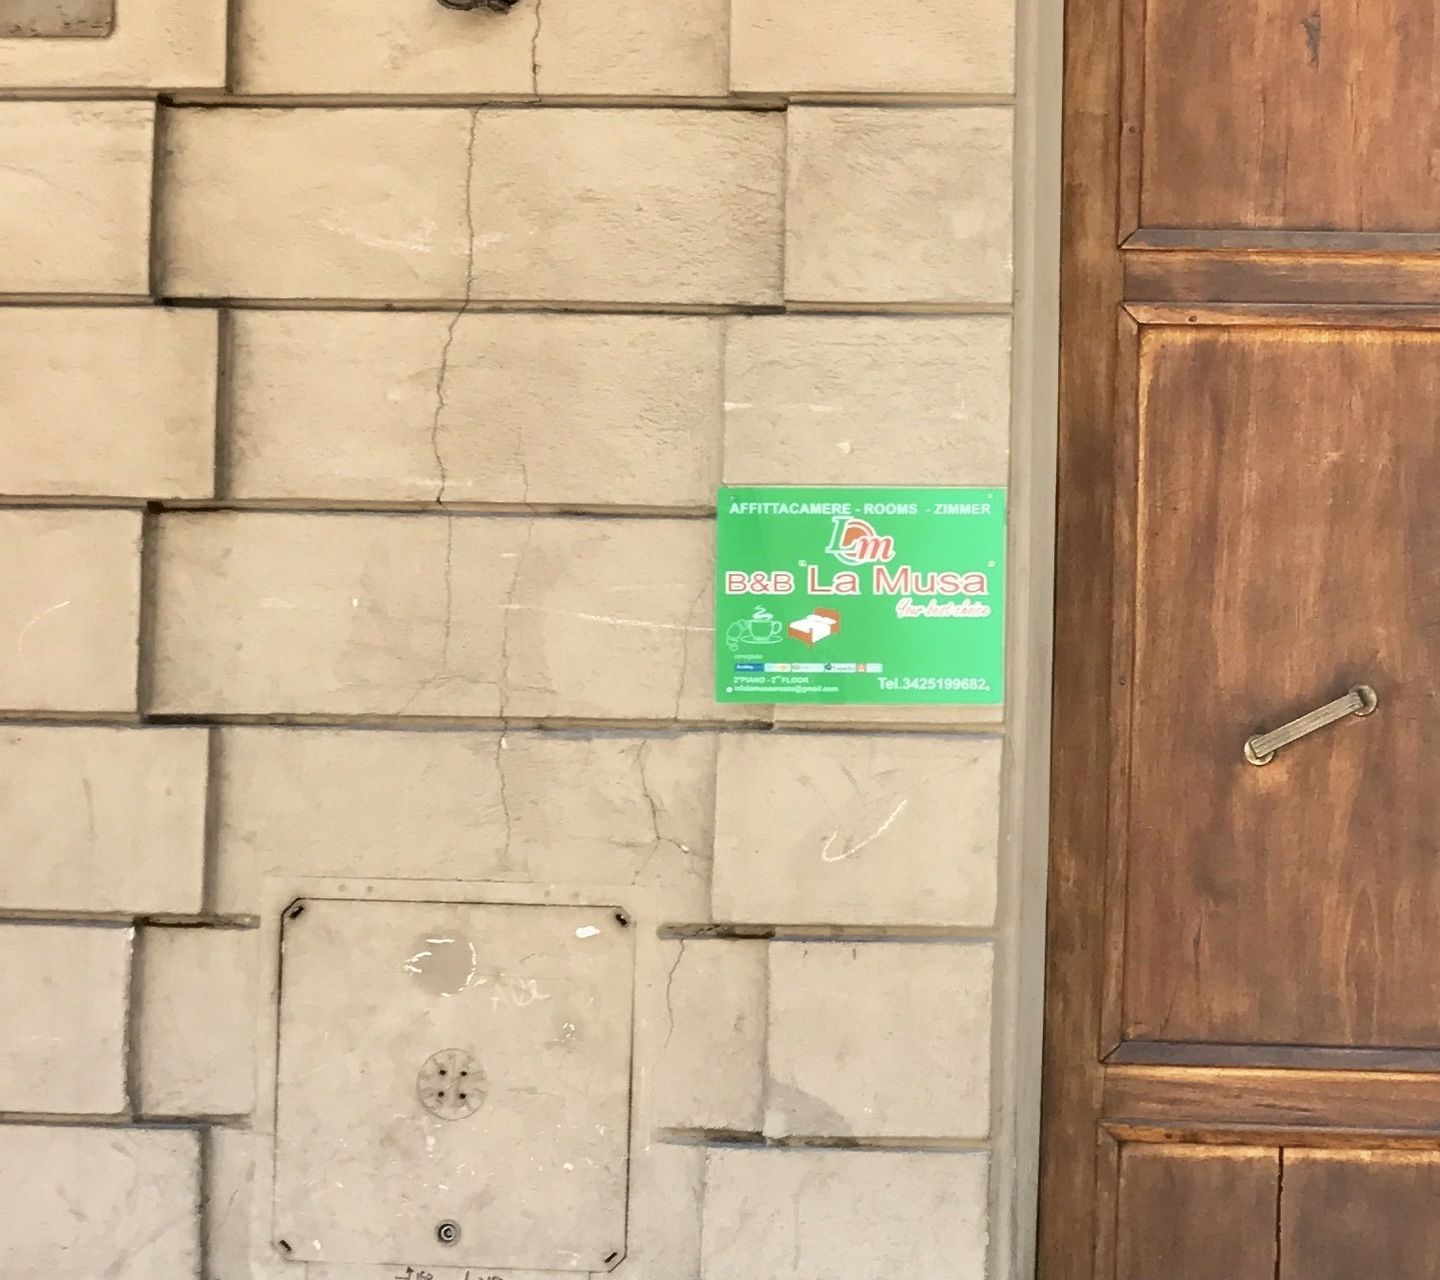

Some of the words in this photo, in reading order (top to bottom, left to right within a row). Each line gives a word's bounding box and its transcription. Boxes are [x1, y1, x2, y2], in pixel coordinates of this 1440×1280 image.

[729, 502, 852, 515] AFFITTACAMERE
[863, 503, 918, 515] ROOMS
[933, 504, 992, 516] ZIMMER
[725, 571, 795, 595] B&B
